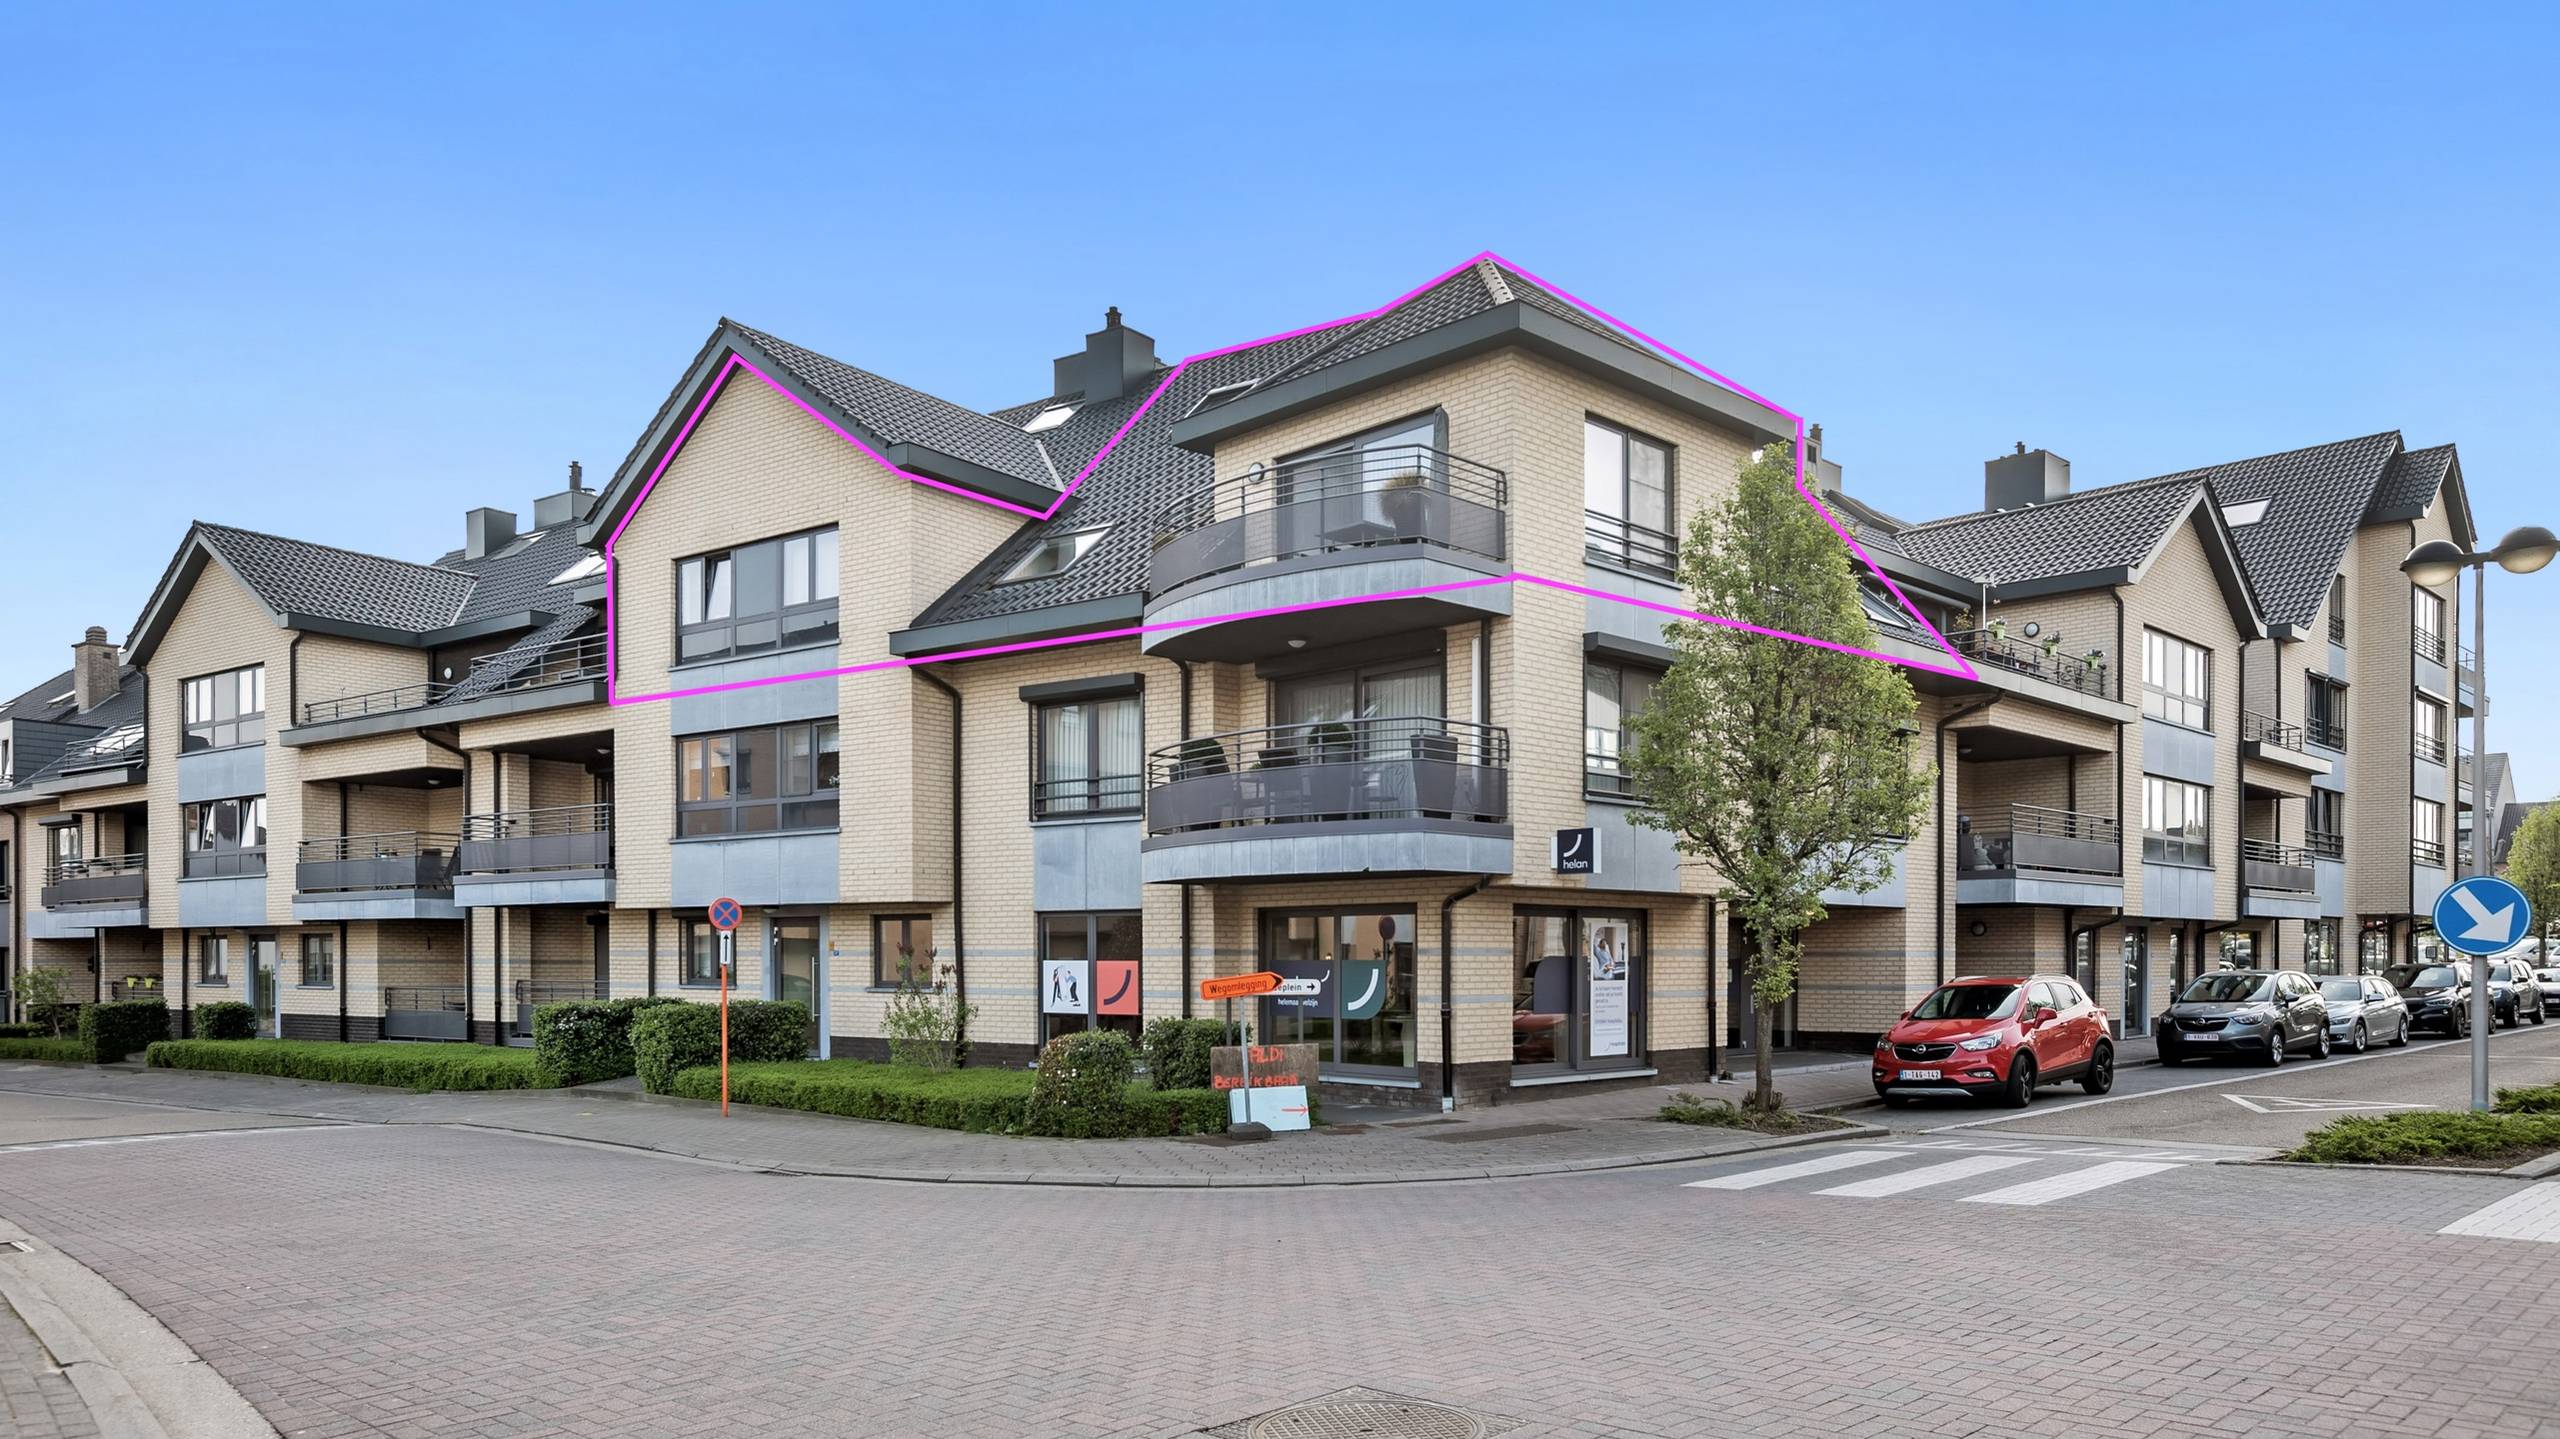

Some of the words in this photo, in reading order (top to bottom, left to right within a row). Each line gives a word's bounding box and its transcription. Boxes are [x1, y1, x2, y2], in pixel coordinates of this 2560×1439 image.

[1563, 859, 1588, 869] helan
[1209, 979, 1267, 995] Wegomlegging
[1274, 983, 1302, 992] eplein
[1248, 1047, 1285, 1063] ALDI
